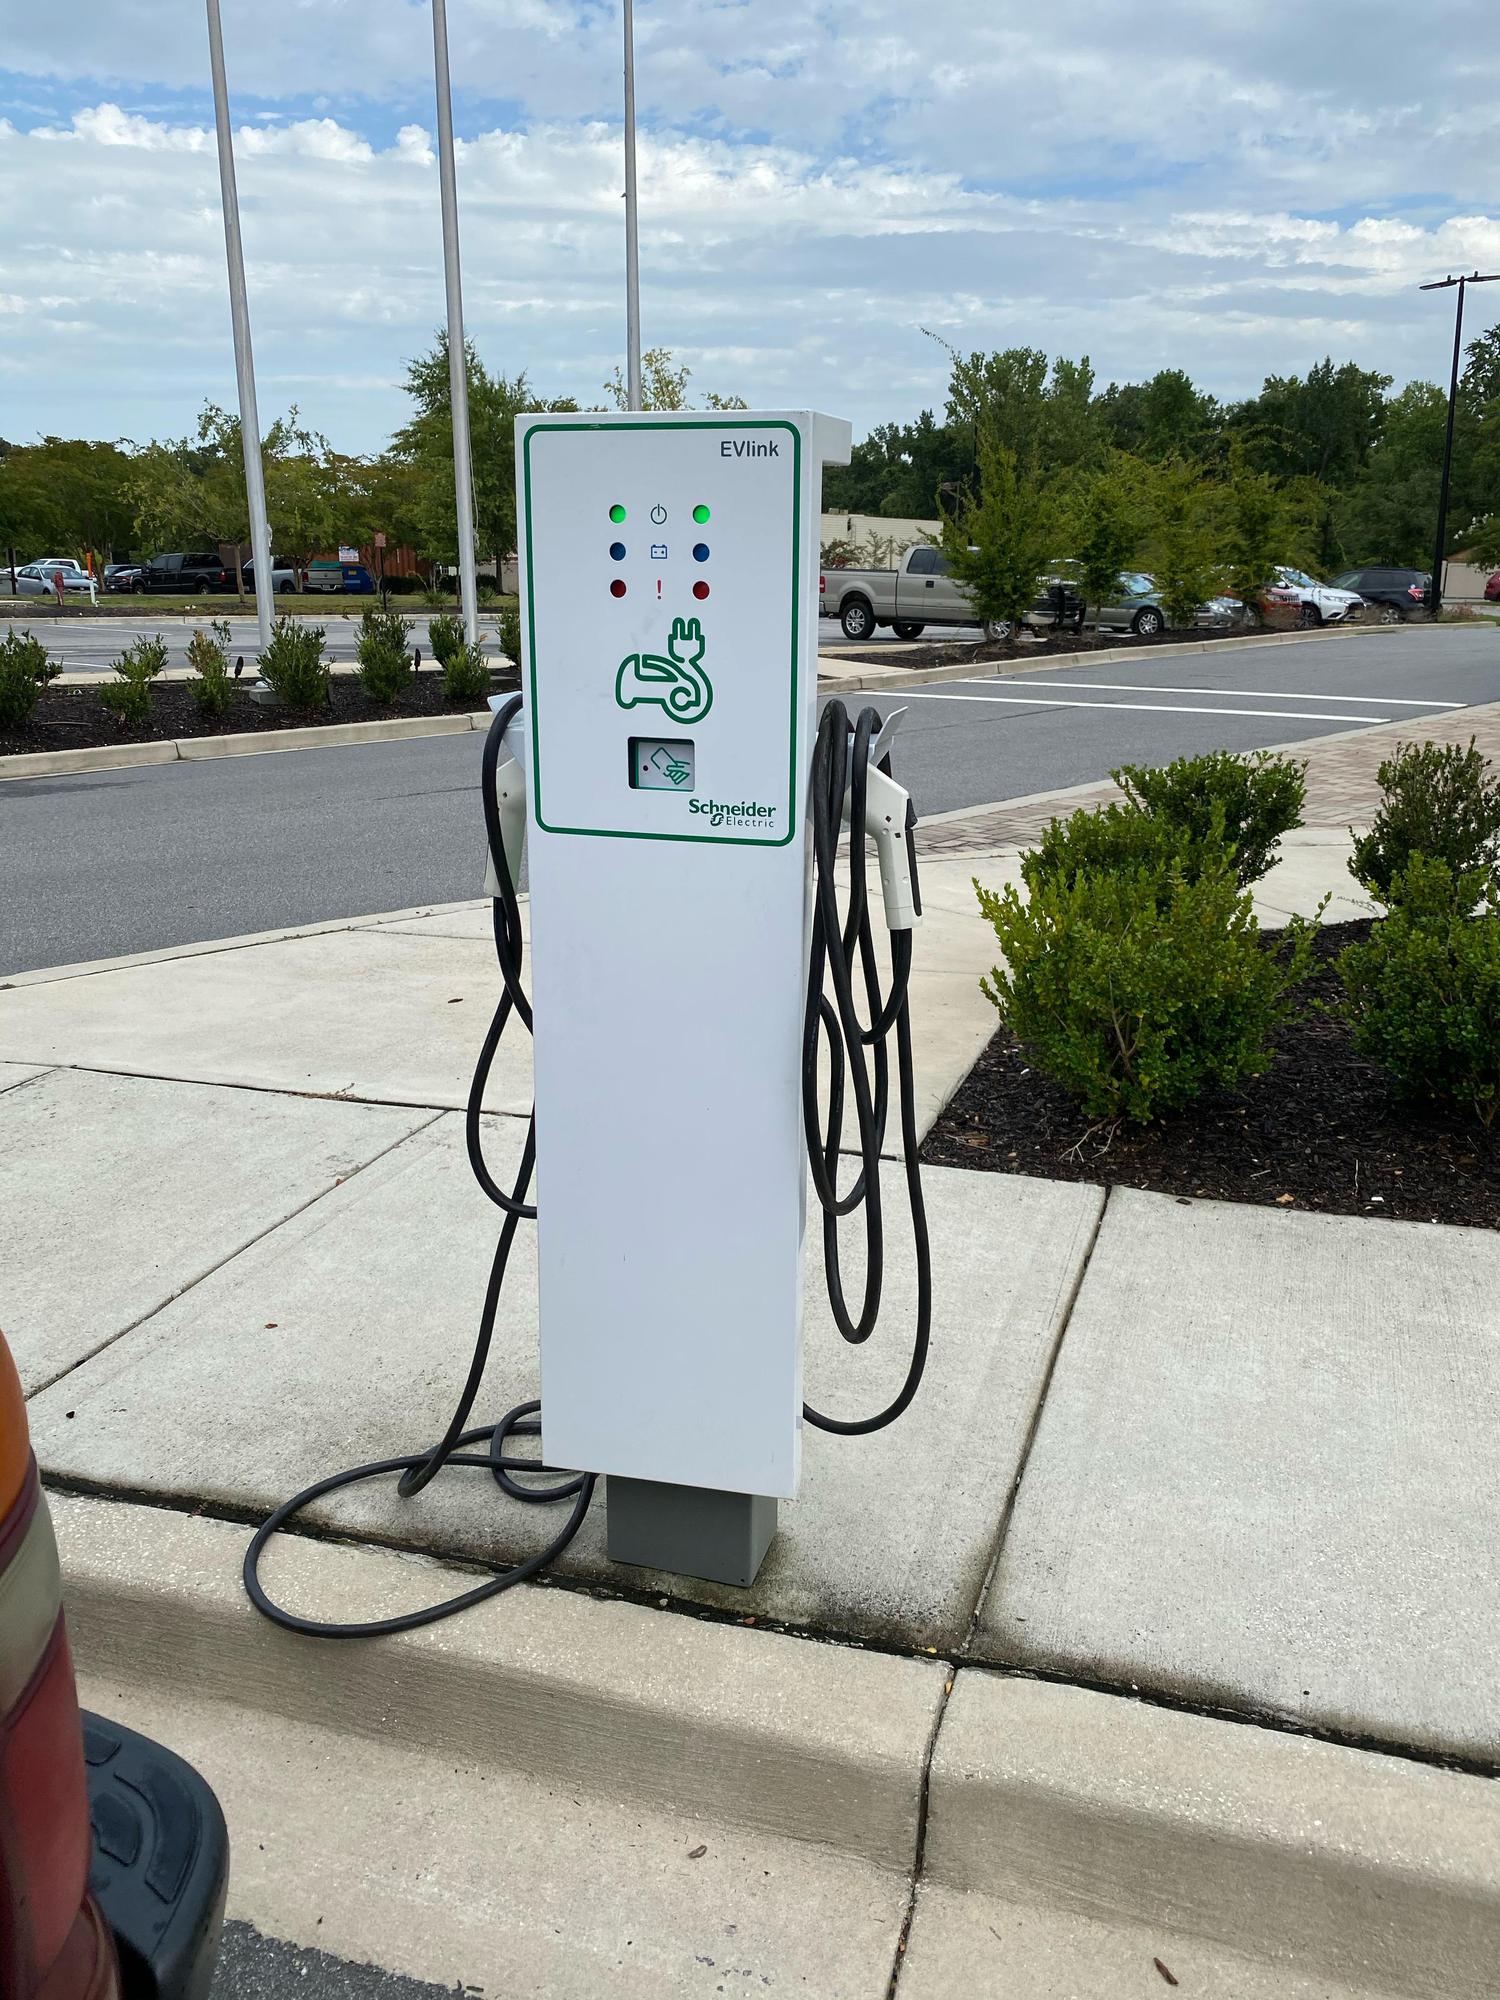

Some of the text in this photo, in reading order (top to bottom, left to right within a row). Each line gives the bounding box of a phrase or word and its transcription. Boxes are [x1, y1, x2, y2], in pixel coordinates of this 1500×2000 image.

[720, 440, 779, 457] EVlink
[688, 798, 776, 817] Schneider
[726, 816, 774, 827] Electric
